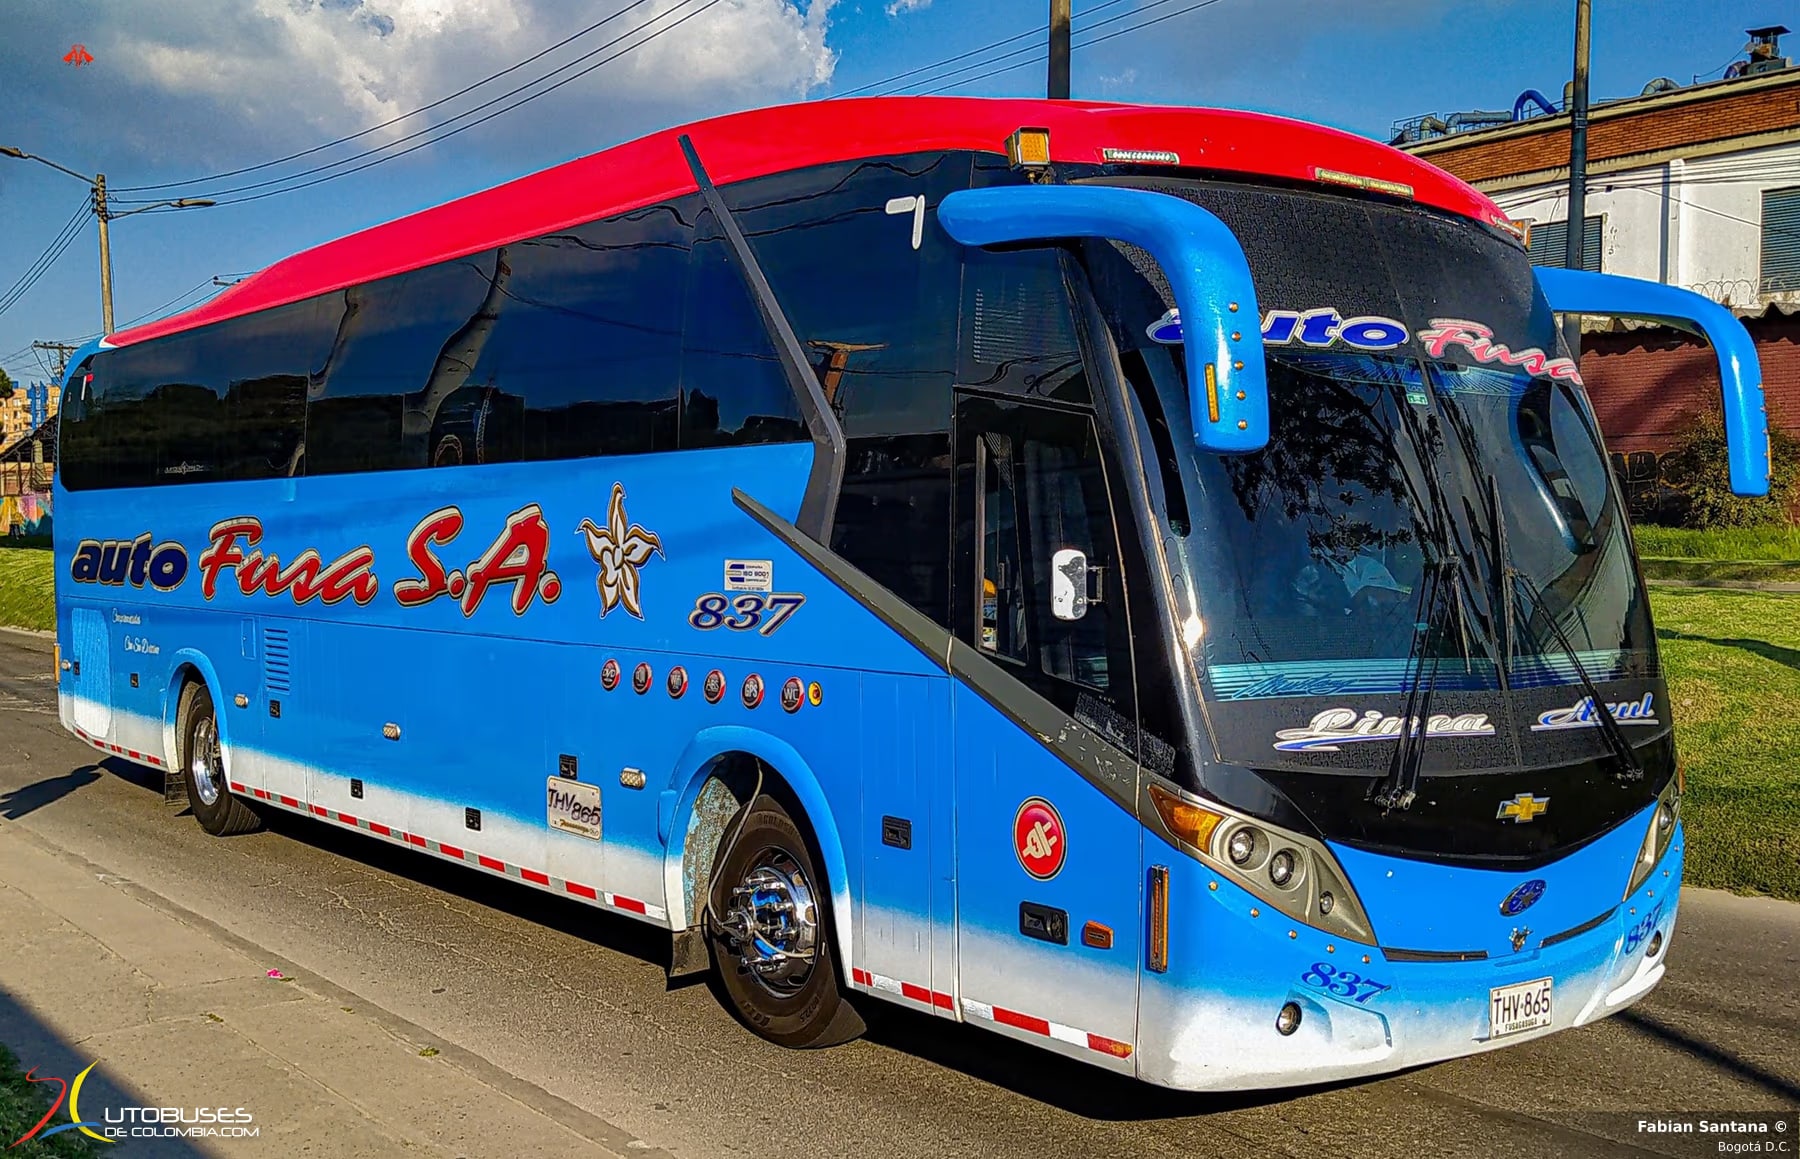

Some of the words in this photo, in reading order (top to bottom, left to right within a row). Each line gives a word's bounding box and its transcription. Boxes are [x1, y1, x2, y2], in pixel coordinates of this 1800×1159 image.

[1415, 317, 1584, 385] Fusa
[71, 531, 189, 592] auto
[199, 515, 379, 607] Fusa
[393, 502, 562, 618] S.A.
[687, 592, 807, 637] 837
[602, 668, 616, 678] DVD
[744, 683, 758, 698] GPS
[783, 688, 799, 700] WC
[1625, 897, 1666, 955] 837
[1301, 962, 1391, 1003] 837
